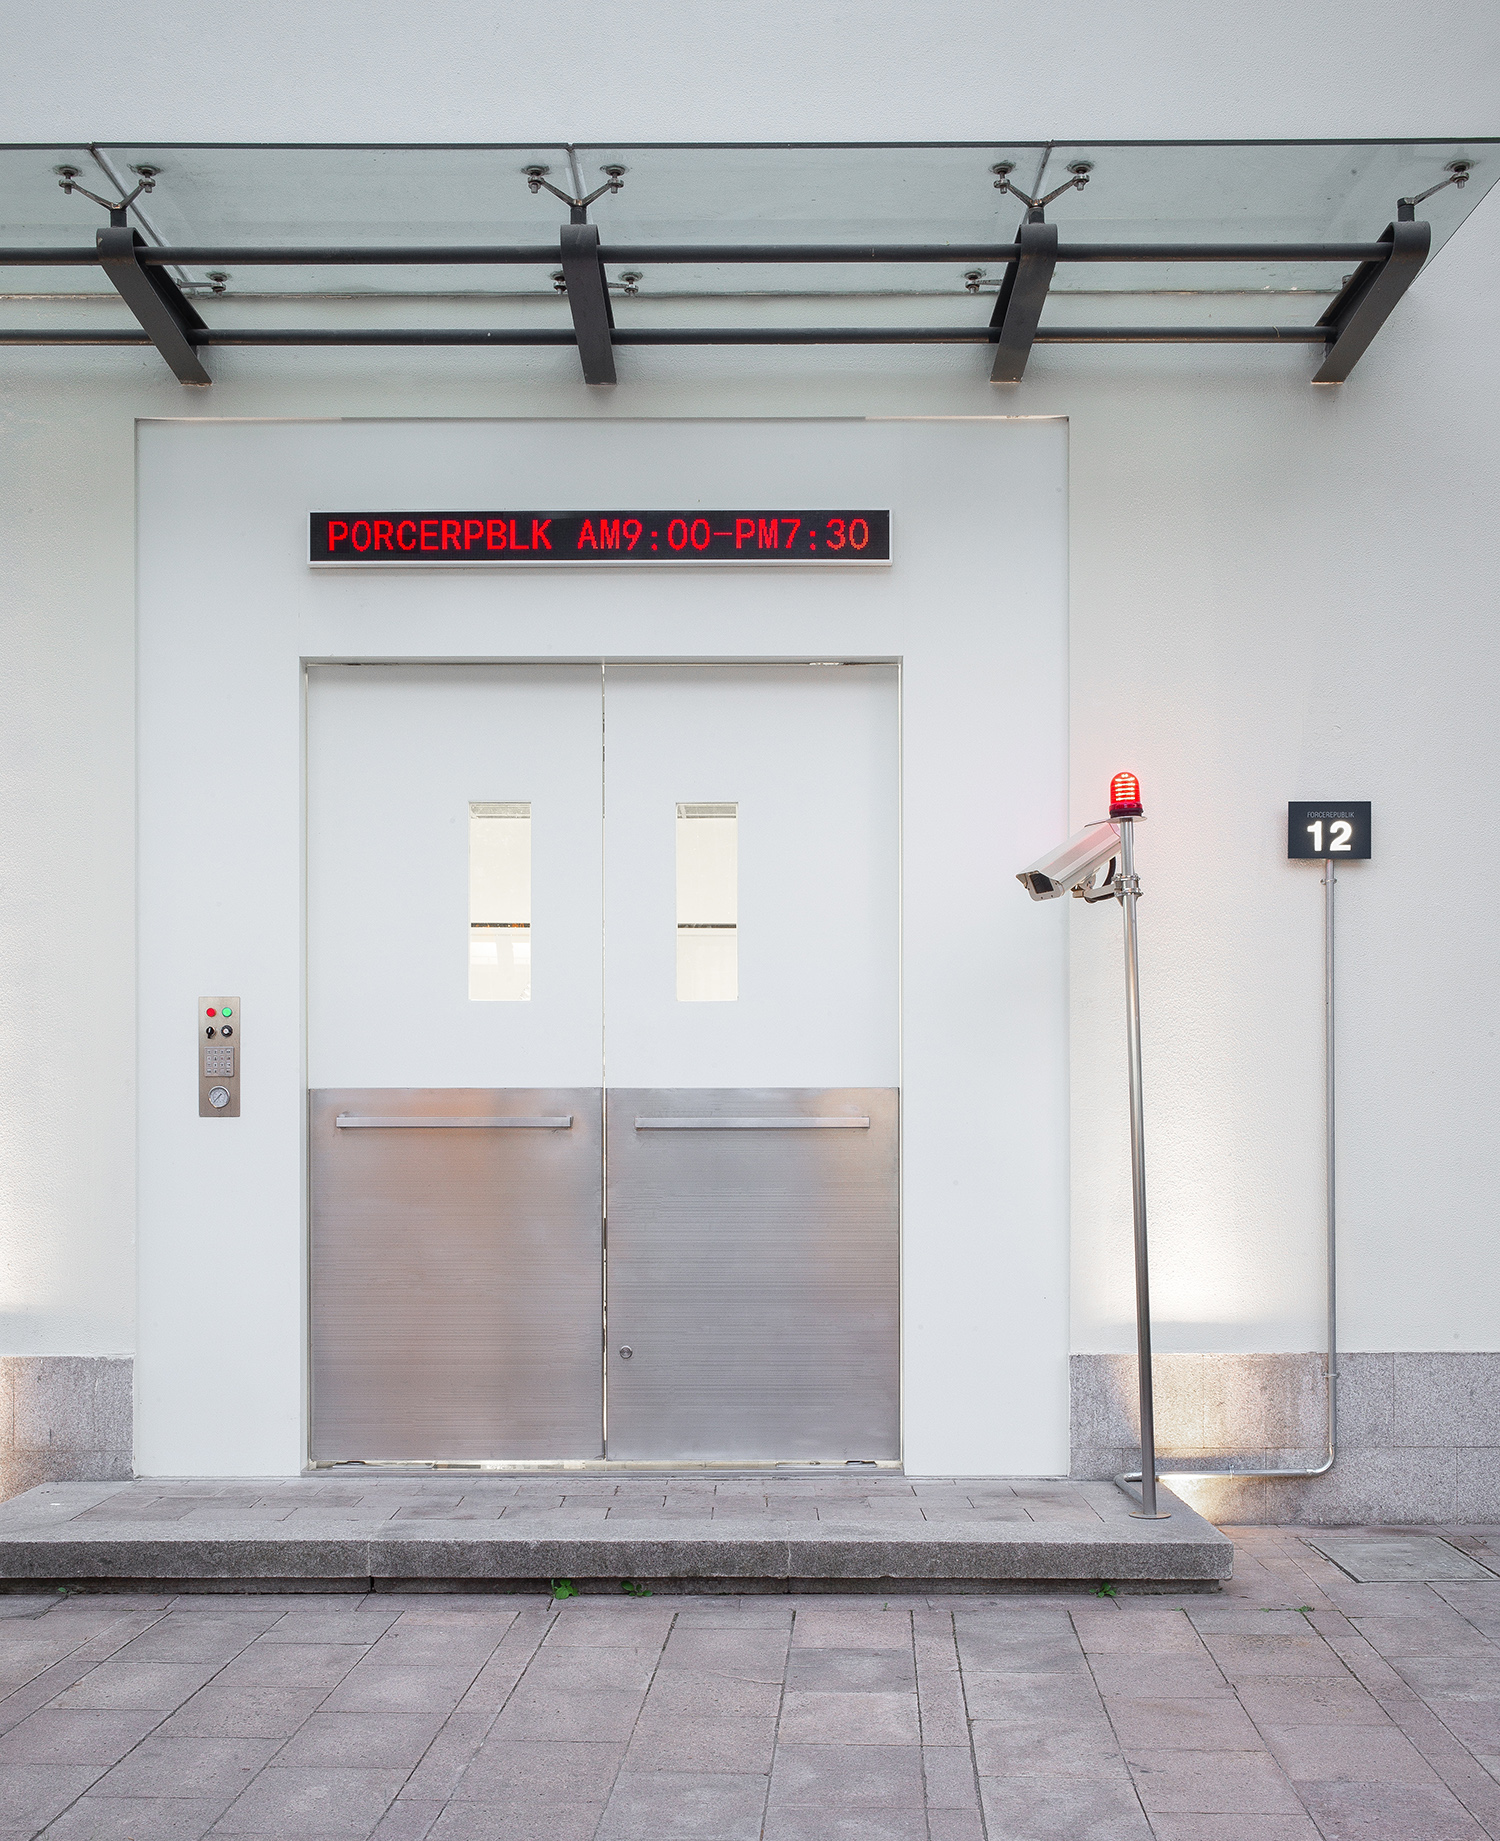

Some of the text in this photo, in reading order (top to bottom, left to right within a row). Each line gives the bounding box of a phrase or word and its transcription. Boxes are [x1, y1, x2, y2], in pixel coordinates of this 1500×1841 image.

[328, 518, 870, 552] PORCERPBLK AM9:00-PM7:30
[1307, 821, 1352, 851] 12
